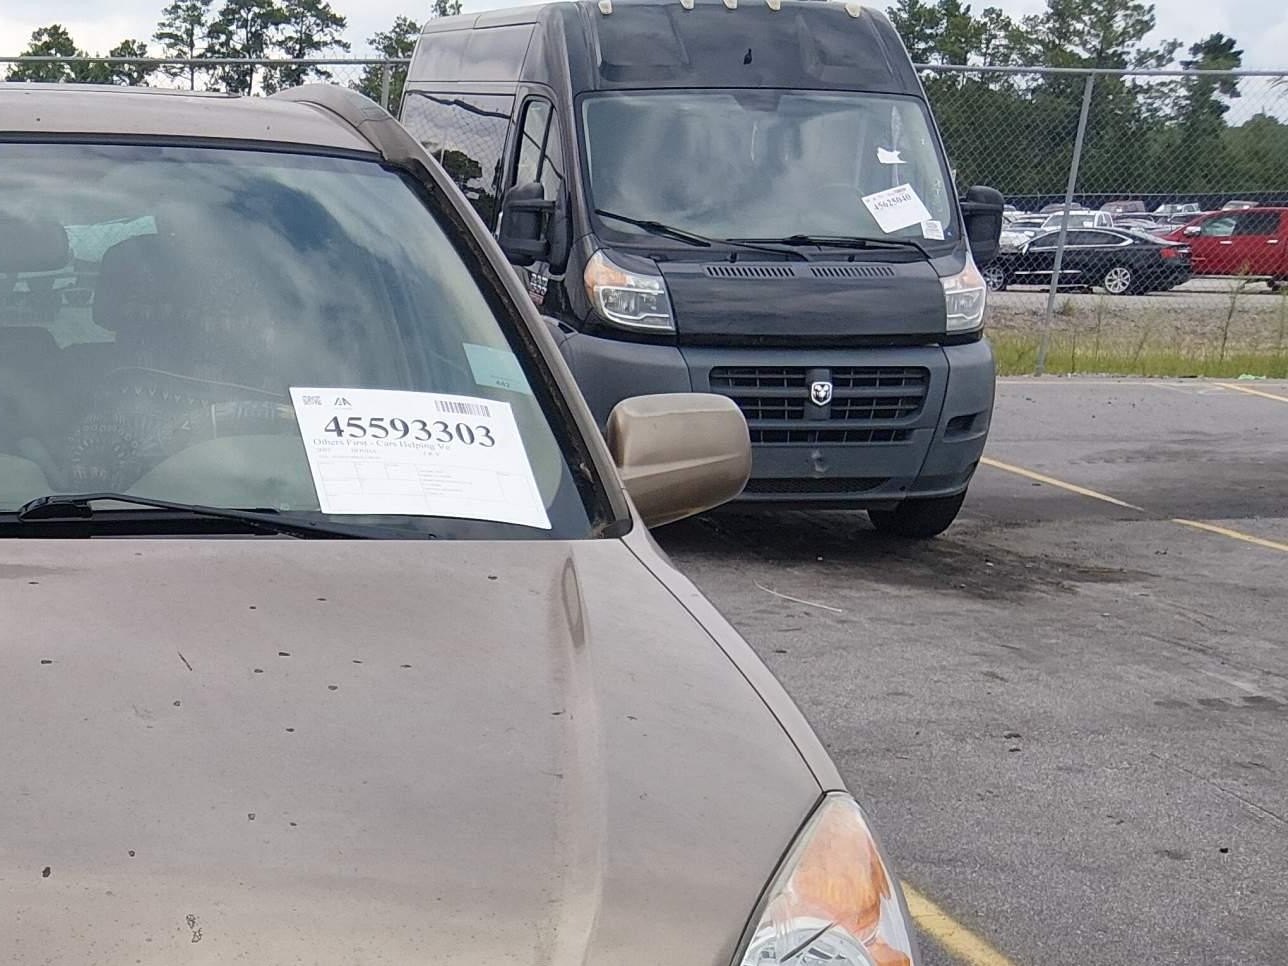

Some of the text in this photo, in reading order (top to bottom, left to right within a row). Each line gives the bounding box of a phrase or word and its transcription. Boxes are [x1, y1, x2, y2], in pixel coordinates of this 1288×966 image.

[324, 415, 495, 448] 45593303
[346, 439, 368, 447] First
[375, 439, 398, 447] Cars
[399, 440, 436, 450] Helping
